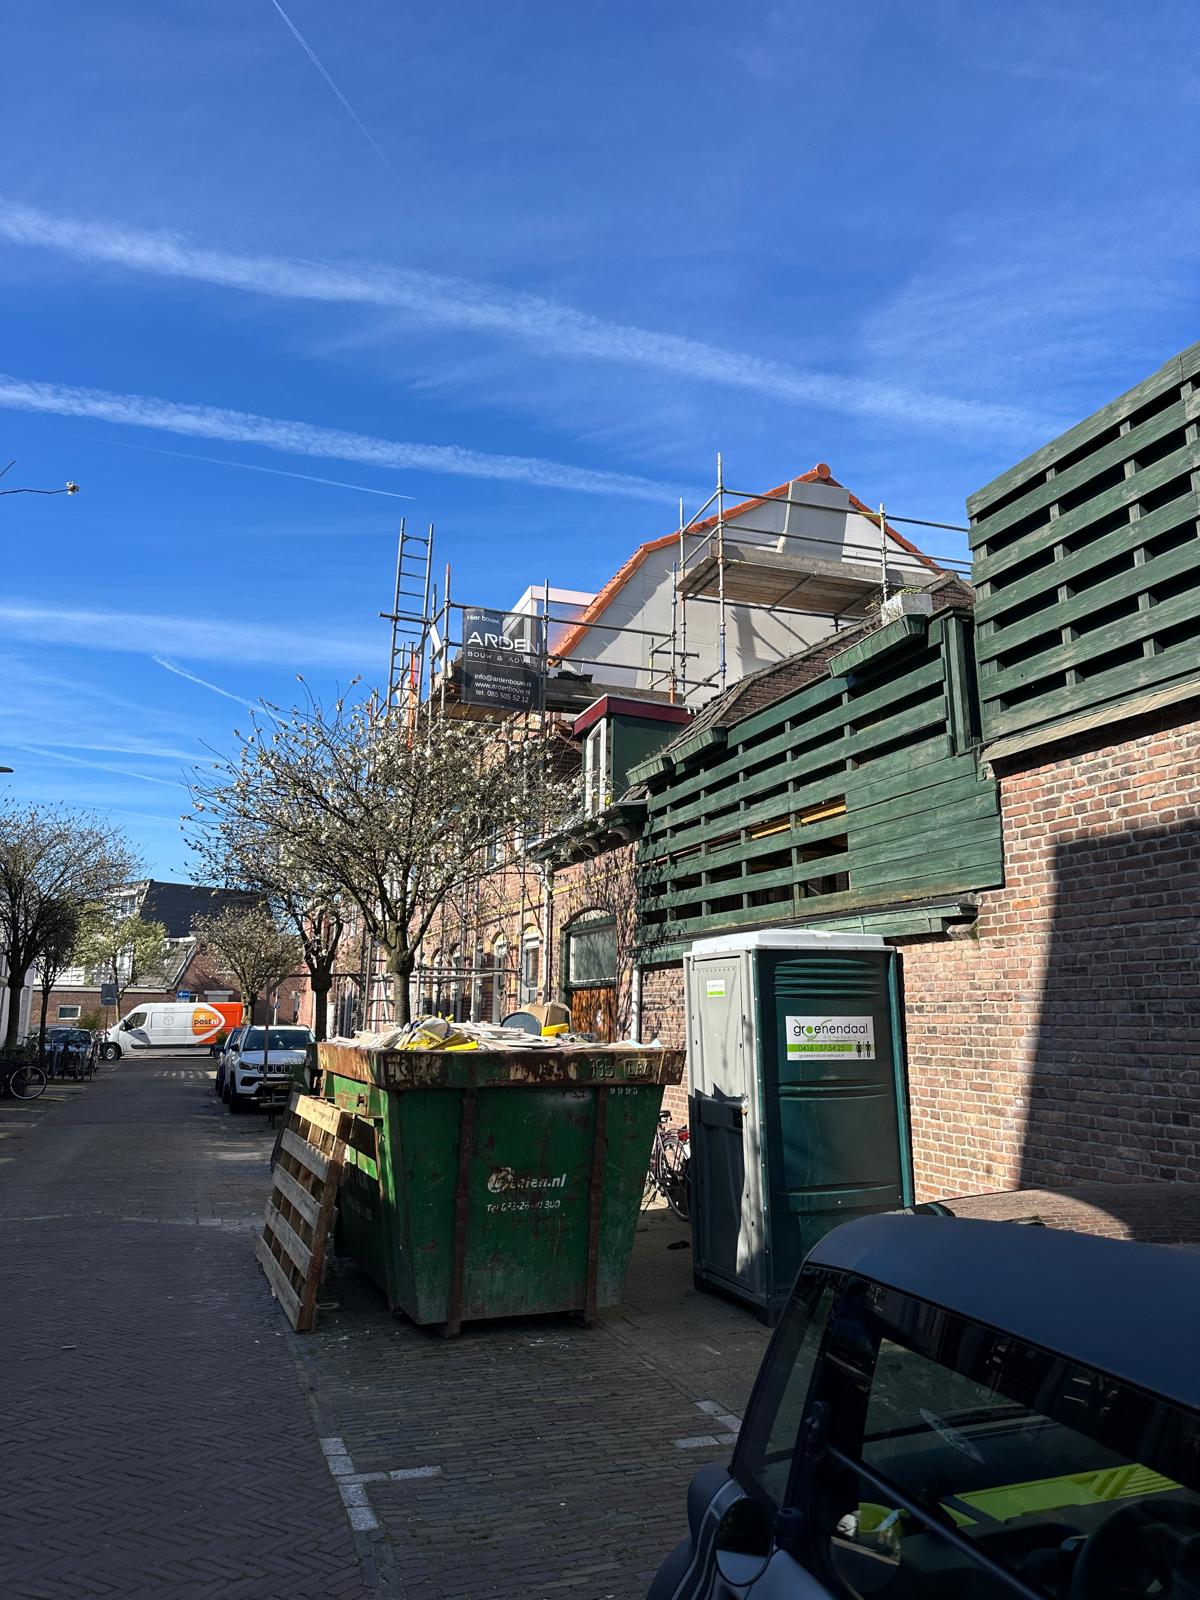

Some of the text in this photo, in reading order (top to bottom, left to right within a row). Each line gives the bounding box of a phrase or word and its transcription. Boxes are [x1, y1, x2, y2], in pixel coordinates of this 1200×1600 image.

[467, 632, 540, 656] ARDEN
[467, 651, 493, 660] BOUW
[794, 1022, 868, 1037] groenendaal
